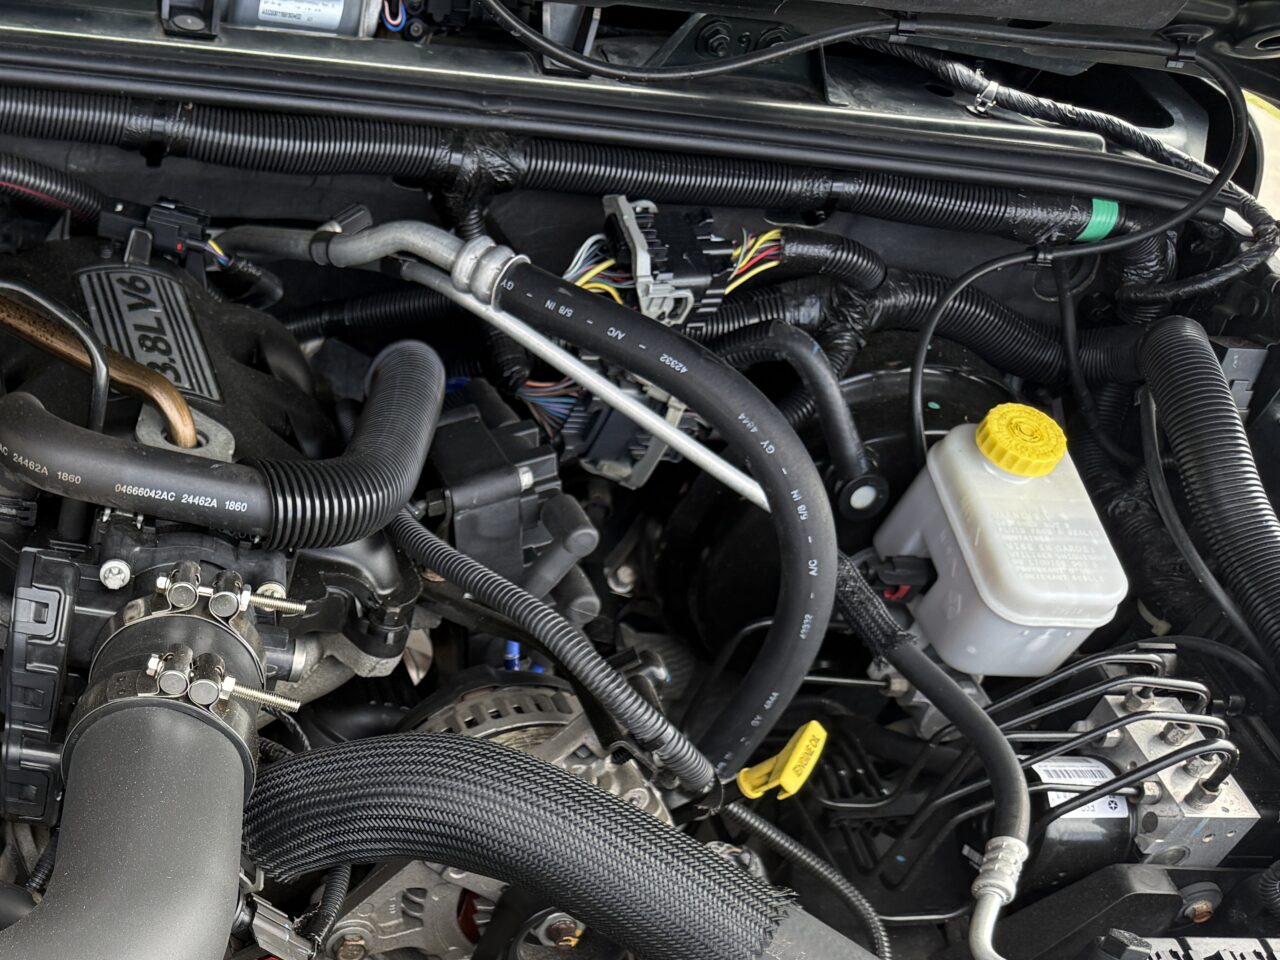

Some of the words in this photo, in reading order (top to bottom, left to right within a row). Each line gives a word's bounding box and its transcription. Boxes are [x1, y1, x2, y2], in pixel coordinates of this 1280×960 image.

[116, 275, 157, 312] V6
[500, 278, 515, 291] GY
[545, 299, 555, 311] IN
[558, 305, 574, 318] 5/8
[606, 326, 626, 341] A/C
[133, 317, 182, 384] 3.8L
[659, 353, 689, 374] 42332
[760, 439, 776, 454] GY
[13, 452, 49, 476] 24462A
[56, 471, 82, 485] 1860
[114, 483, 176, 501] 04666042AC
[182, 493, 218, 508] 24462A
[224, 500, 248, 512] 1860
[807, 559, 819, 576] A/C
[792, 744, 816, 777] ENGINE
